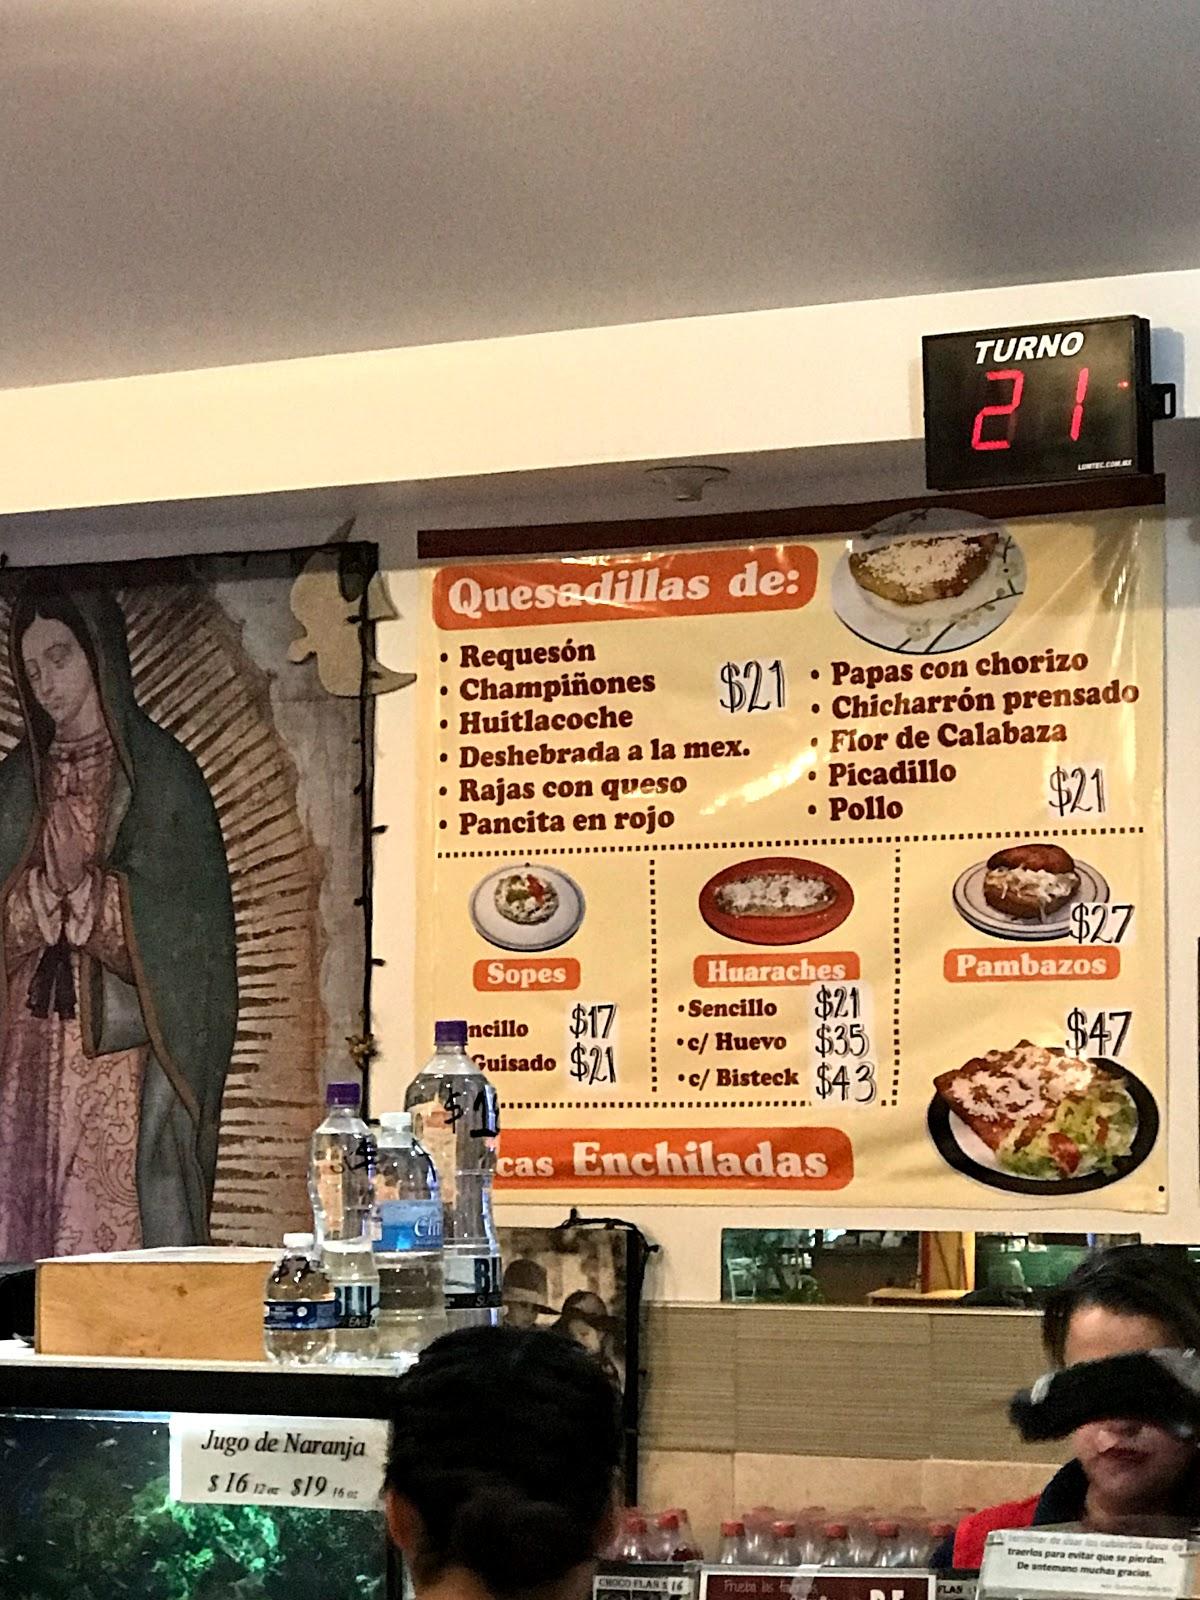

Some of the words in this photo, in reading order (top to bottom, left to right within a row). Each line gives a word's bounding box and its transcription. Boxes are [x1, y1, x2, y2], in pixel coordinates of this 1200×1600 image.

[974, 331, 1085, 364] TURNO
[448, 567, 710, 619] Quesadillas
[728, 560, 800, 598] de:
[459, 638, 596, 671] Requesón
[831, 659, 914, 690] Papas
[920, 657, 968, 680] con
[975, 648, 1089, 676] chorizo
[459, 671, 656, 703] Champiñones
[719, 658, 785, 714] $21
[831, 687, 995, 720] Chicharrón
[1003, 680, 1140, 714] prensado
[459, 705, 633, 735] Huitlacoche
[458, 741, 621, 769] Deshebrada
[627, 744, 643, 762] a
[650, 738, 677, 761] la
[683, 739, 751, 760] mex.
[829, 726, 889, 754] Flor
[895, 725, 930, 749] de
[937, 721, 1068, 748] Calabaza
[828, 758, 957, 787] Picadillo
[459, 777, 536, 807] Rajas
[542, 778, 593, 799] con
[601, 775, 687, 803] queso
[1048, 765, 1107, 818] $21
[459, 810, 566, 836] Pancita
[572, 812, 606, 831] en
[614, 806, 676, 835] rojo
[828, 795, 905, 822] Pollo
[1069, 902, 1135, 946] $27
[487, 962, 567, 988] Sopes
[707, 959, 847, 983] Huaraches
[956, 952, 1108, 978] Pambazos
[688, 998, 778, 1018] Sencillo
[814, 984, 861, 1020] $21
[467, 1020, 529, 1039] ncillo
[569, 1002, 617, 1040] $17
[1064, 1006, 1134, 1058] $47
[687, 1031, 710, 1056] c/
[715, 1031, 788, 1052] Huevo
[814, 1022, 870, 1059] $35
[569, 1041, 617, 1085] $21
[688, 1067, 711, 1092] c/
[715, 1067, 800, 1089] Bisteck
[814, 1061, 879, 1106] $43
[496, 1154, 555, 1179] cas
[572, 1140, 829, 1179] Enchiladas
[201, 1429, 250, 1457] Jugo
[255, 1431, 280, 1453] de
[283, 1432, 366, 1462] Naranja
[291, 1475, 328, 1497] $19
[332, 1487, 346, 1499] 16
[1008, 1547, 1043, 1557] traerlos
[1044, 1550, 1066, 1559] para
[1067, 1551, 1095, 1560] evitar
[1096, 1553, 1114, 1562] que
[1116, 1554, 1127, 1562] se
[1017, 1561, 1029, 1570] De
[1032, 1563, 1079, 1573] antemano
[1080, 1566, 1115, 1576] muchas
